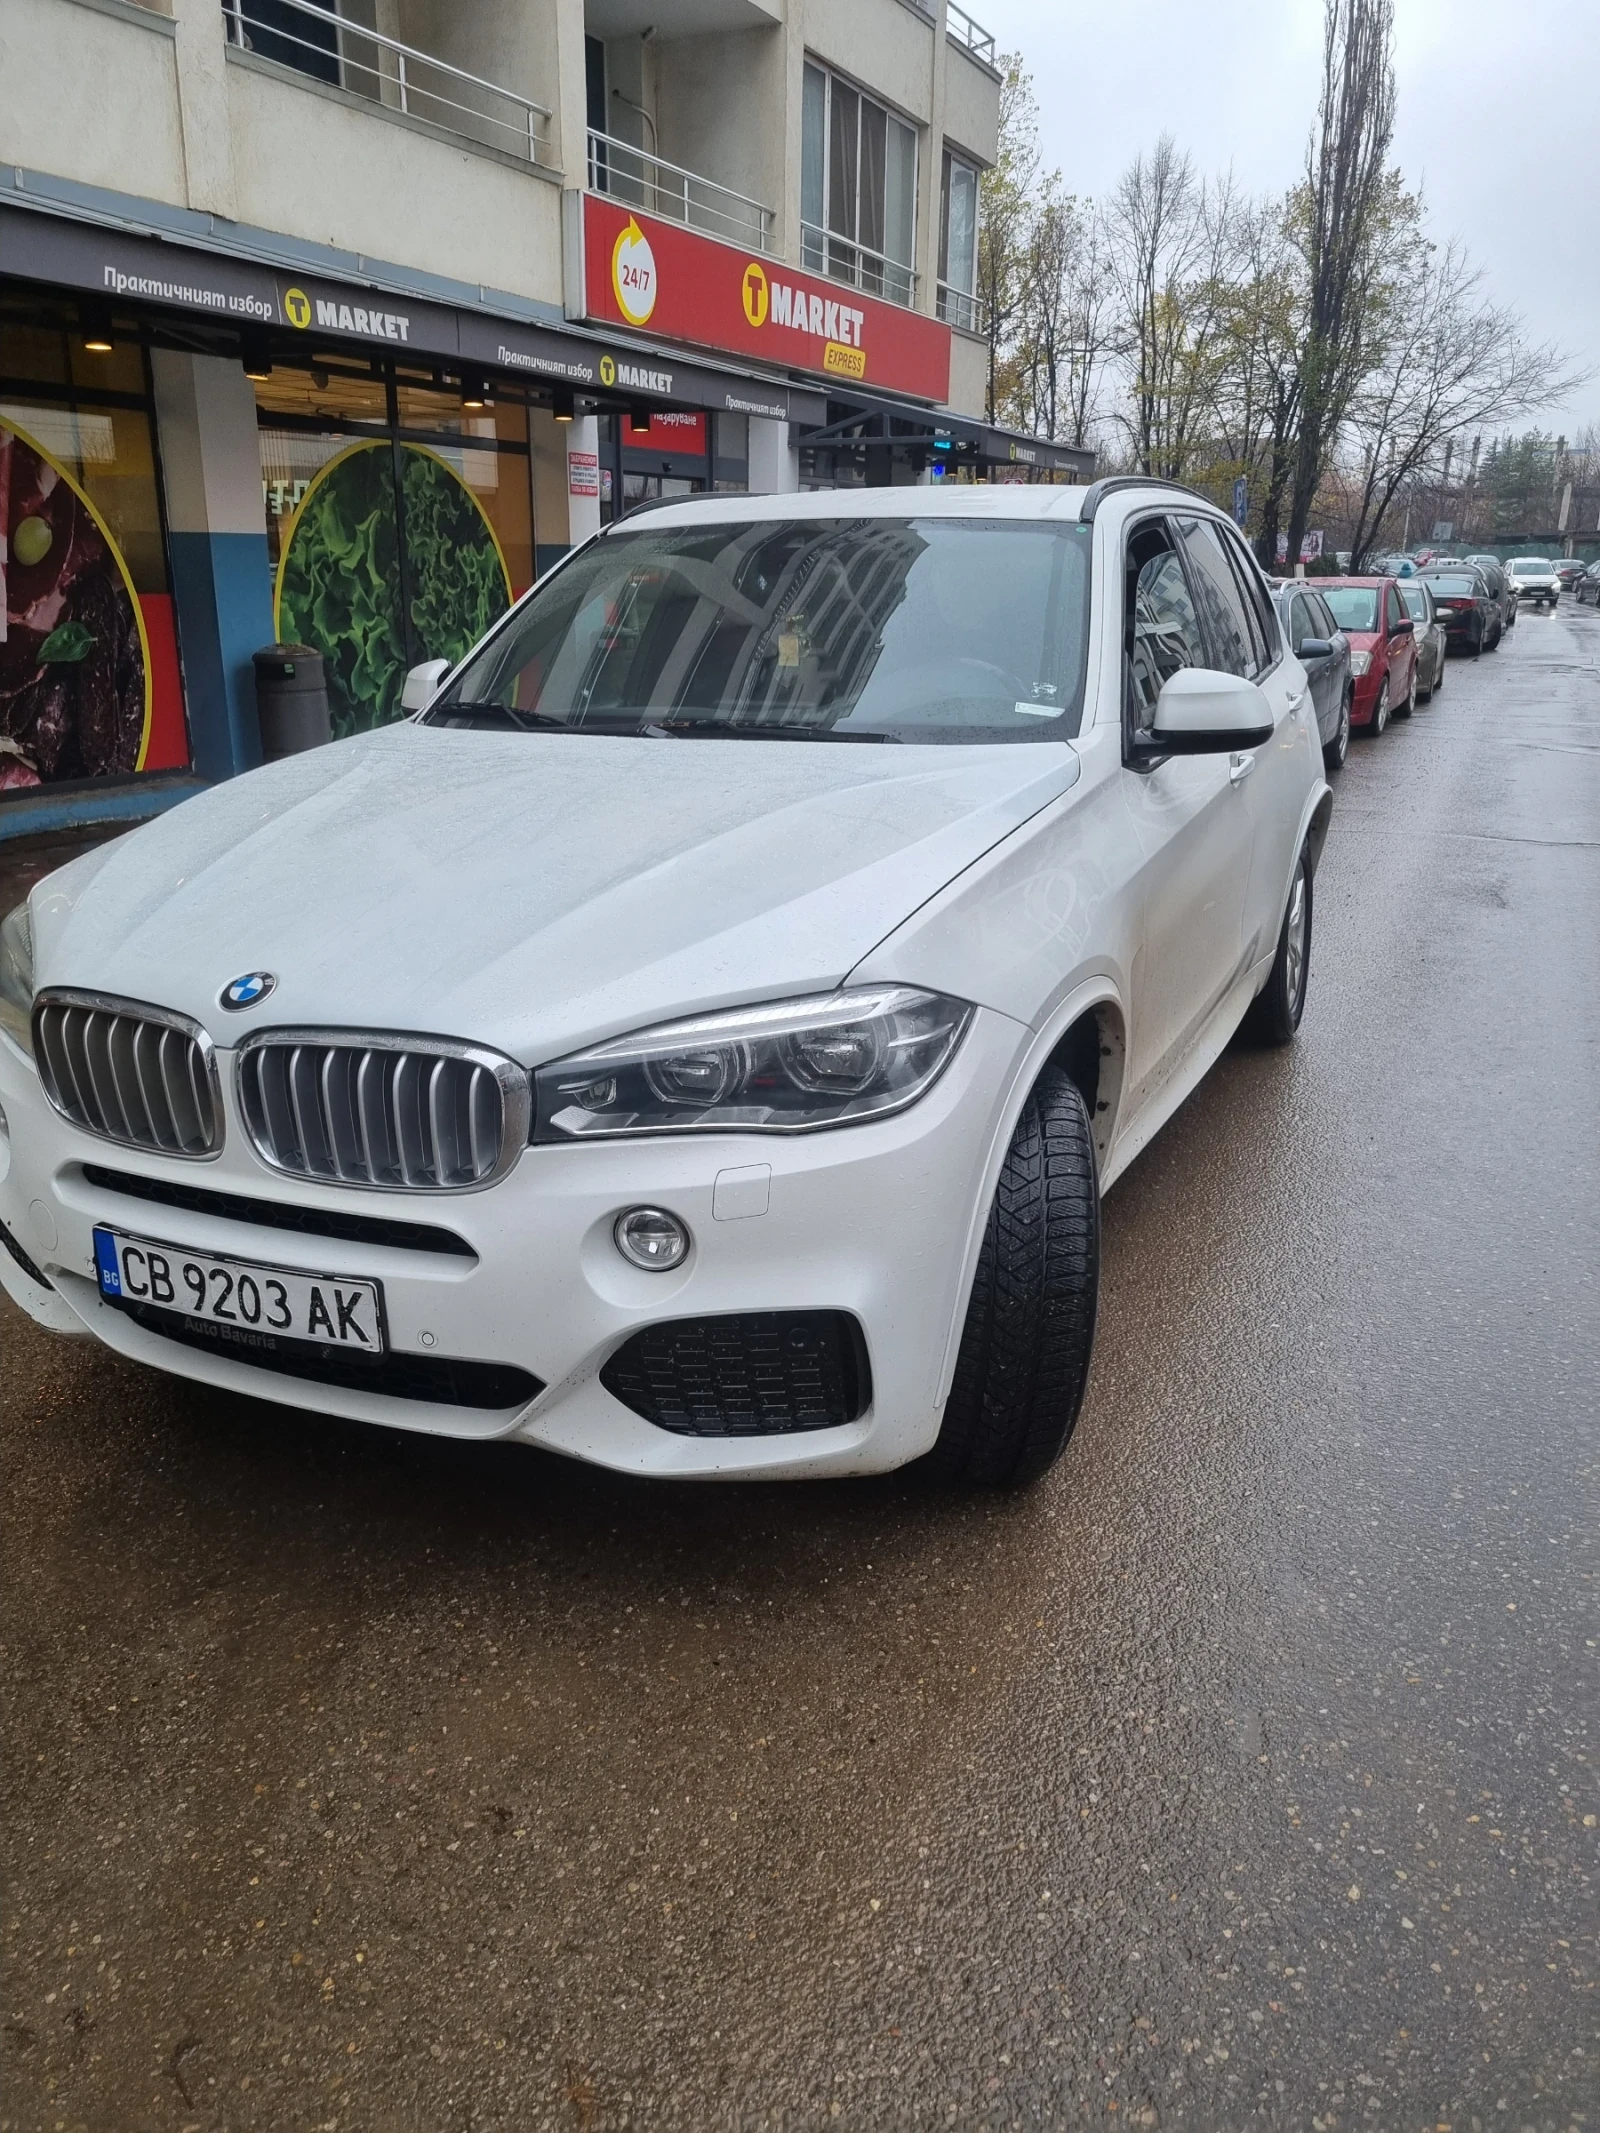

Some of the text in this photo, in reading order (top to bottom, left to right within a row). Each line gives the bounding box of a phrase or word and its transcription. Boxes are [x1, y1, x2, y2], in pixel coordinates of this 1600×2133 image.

[104, 266, 272, 320] Практичният избор
[623, 264, 650, 291] 24/7
[316, 299, 409, 341] MARKET
[771, 281, 864, 347] MARKET
[498, 346, 593, 382] Практичният избор
[827, 349, 862, 373] EXPRESS
[617, 363, 673, 393] MARKET
[725, 394, 786, 420] Практичният избор
[103, 1269, 118, 1286] BG
[122, 1246, 371, 1343] CB 9203 AK
[184, 1316, 276, 1349] Auto Bavaria
